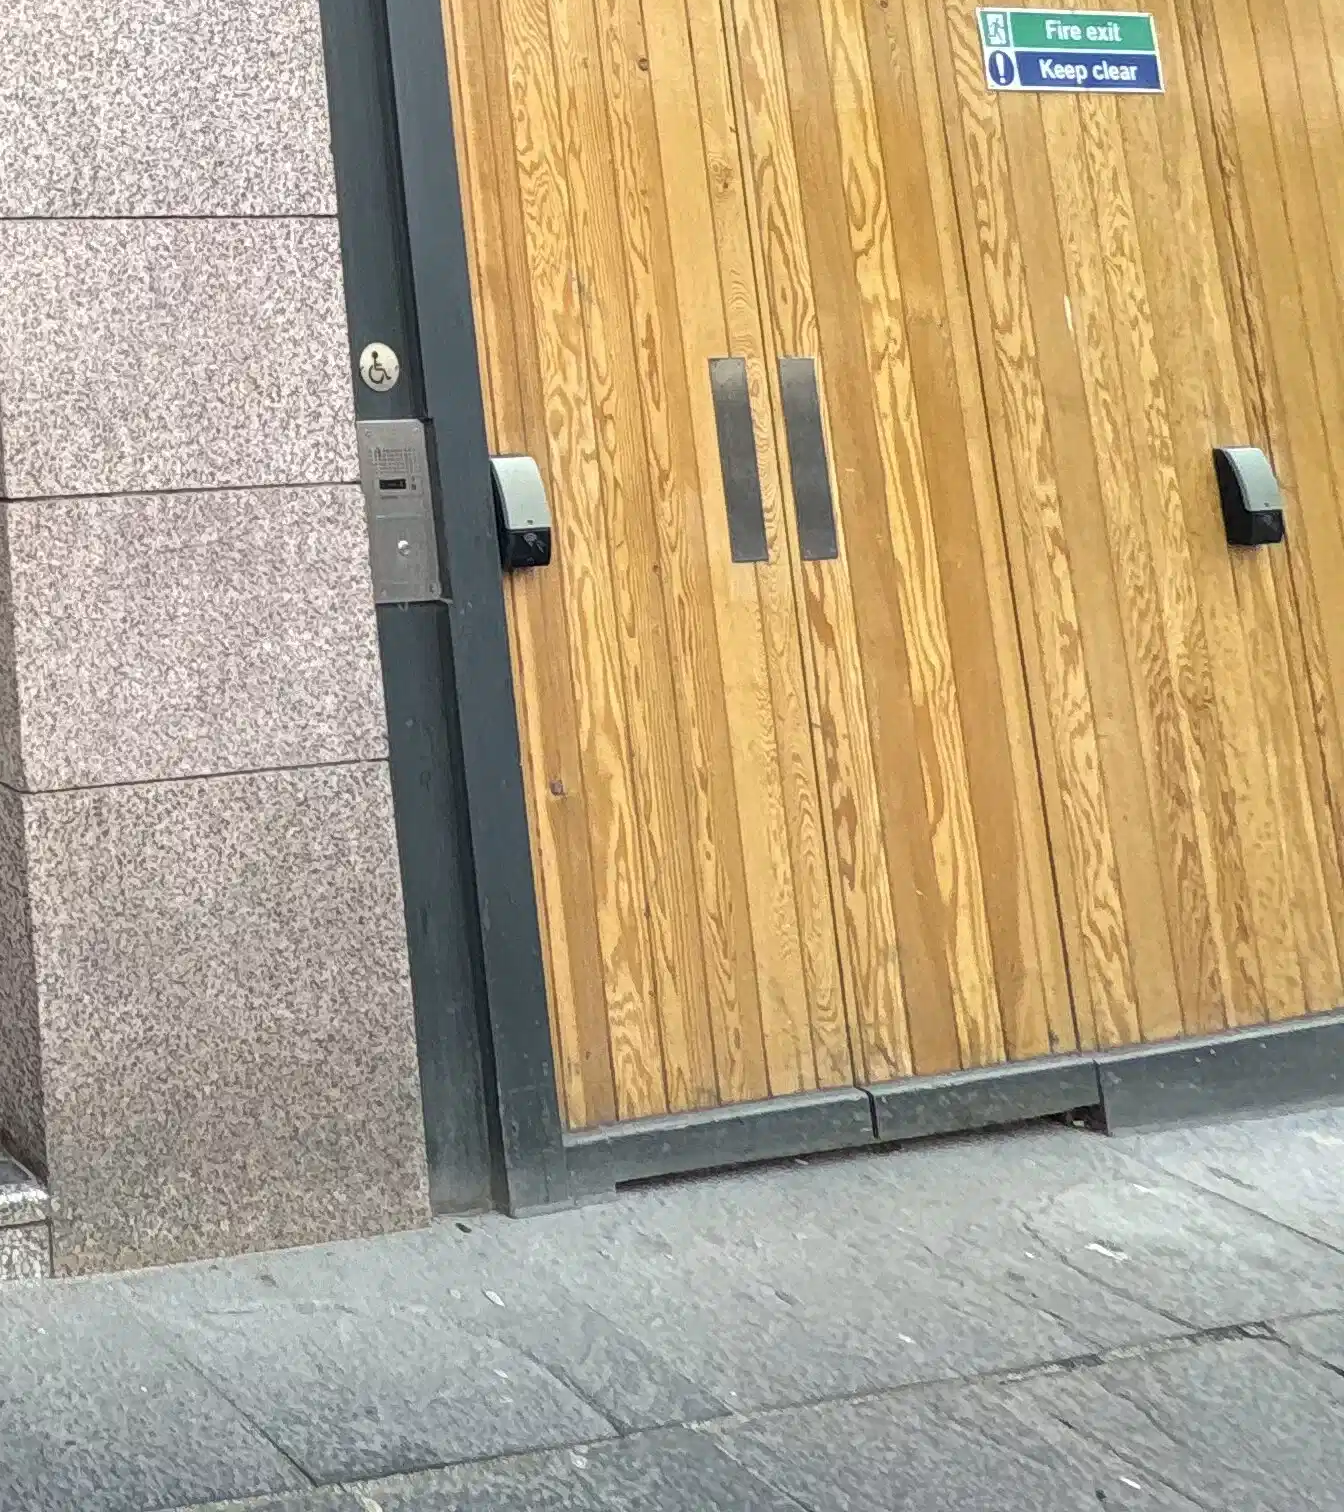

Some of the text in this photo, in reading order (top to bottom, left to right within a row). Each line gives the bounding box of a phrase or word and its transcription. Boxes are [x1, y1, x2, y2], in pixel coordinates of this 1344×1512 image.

[1044, 19, 1123, 42] Fire exit
[1037, 58, 1138, 85] Keep clear
